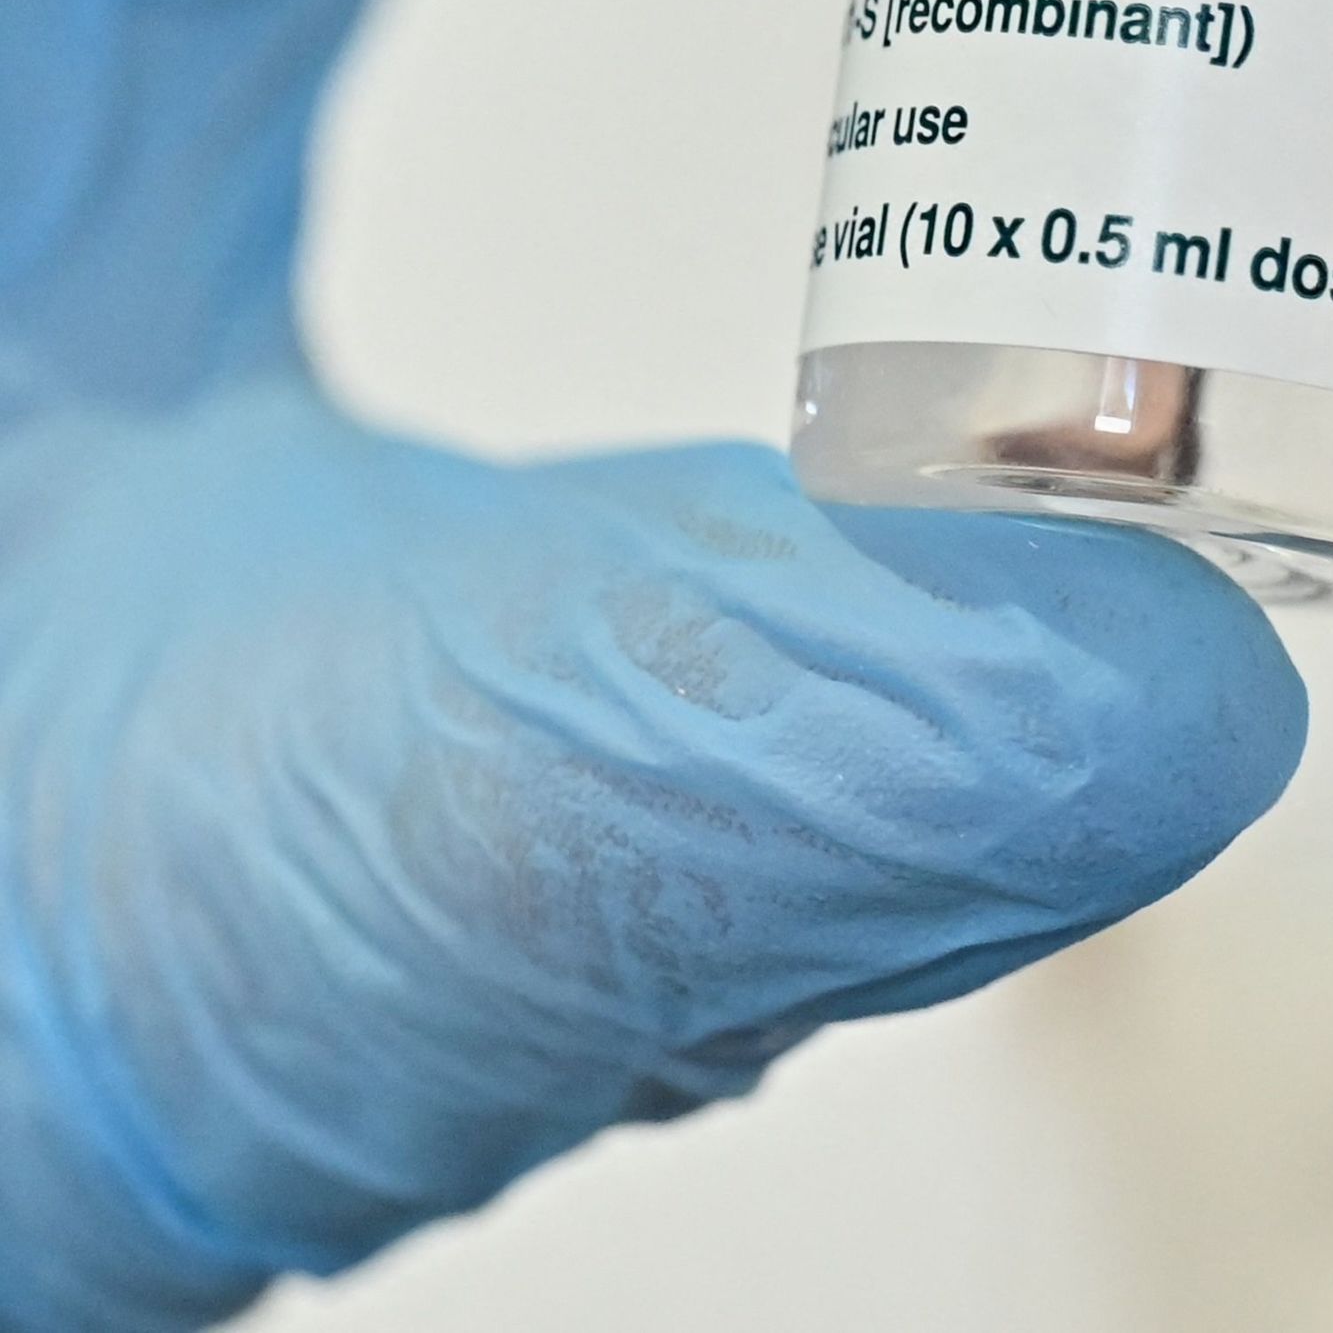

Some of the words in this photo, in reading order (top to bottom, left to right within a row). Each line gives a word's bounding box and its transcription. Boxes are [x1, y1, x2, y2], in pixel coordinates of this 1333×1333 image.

[893, 104, 968, 146] use
[834, 202, 890, 261] vial
[900, 201, 974, 269] (10
[987, 215, 1026, 259] x
[1041, 207, 1134, 269] 0.5
[1152, 226, 1233, 282] ml
